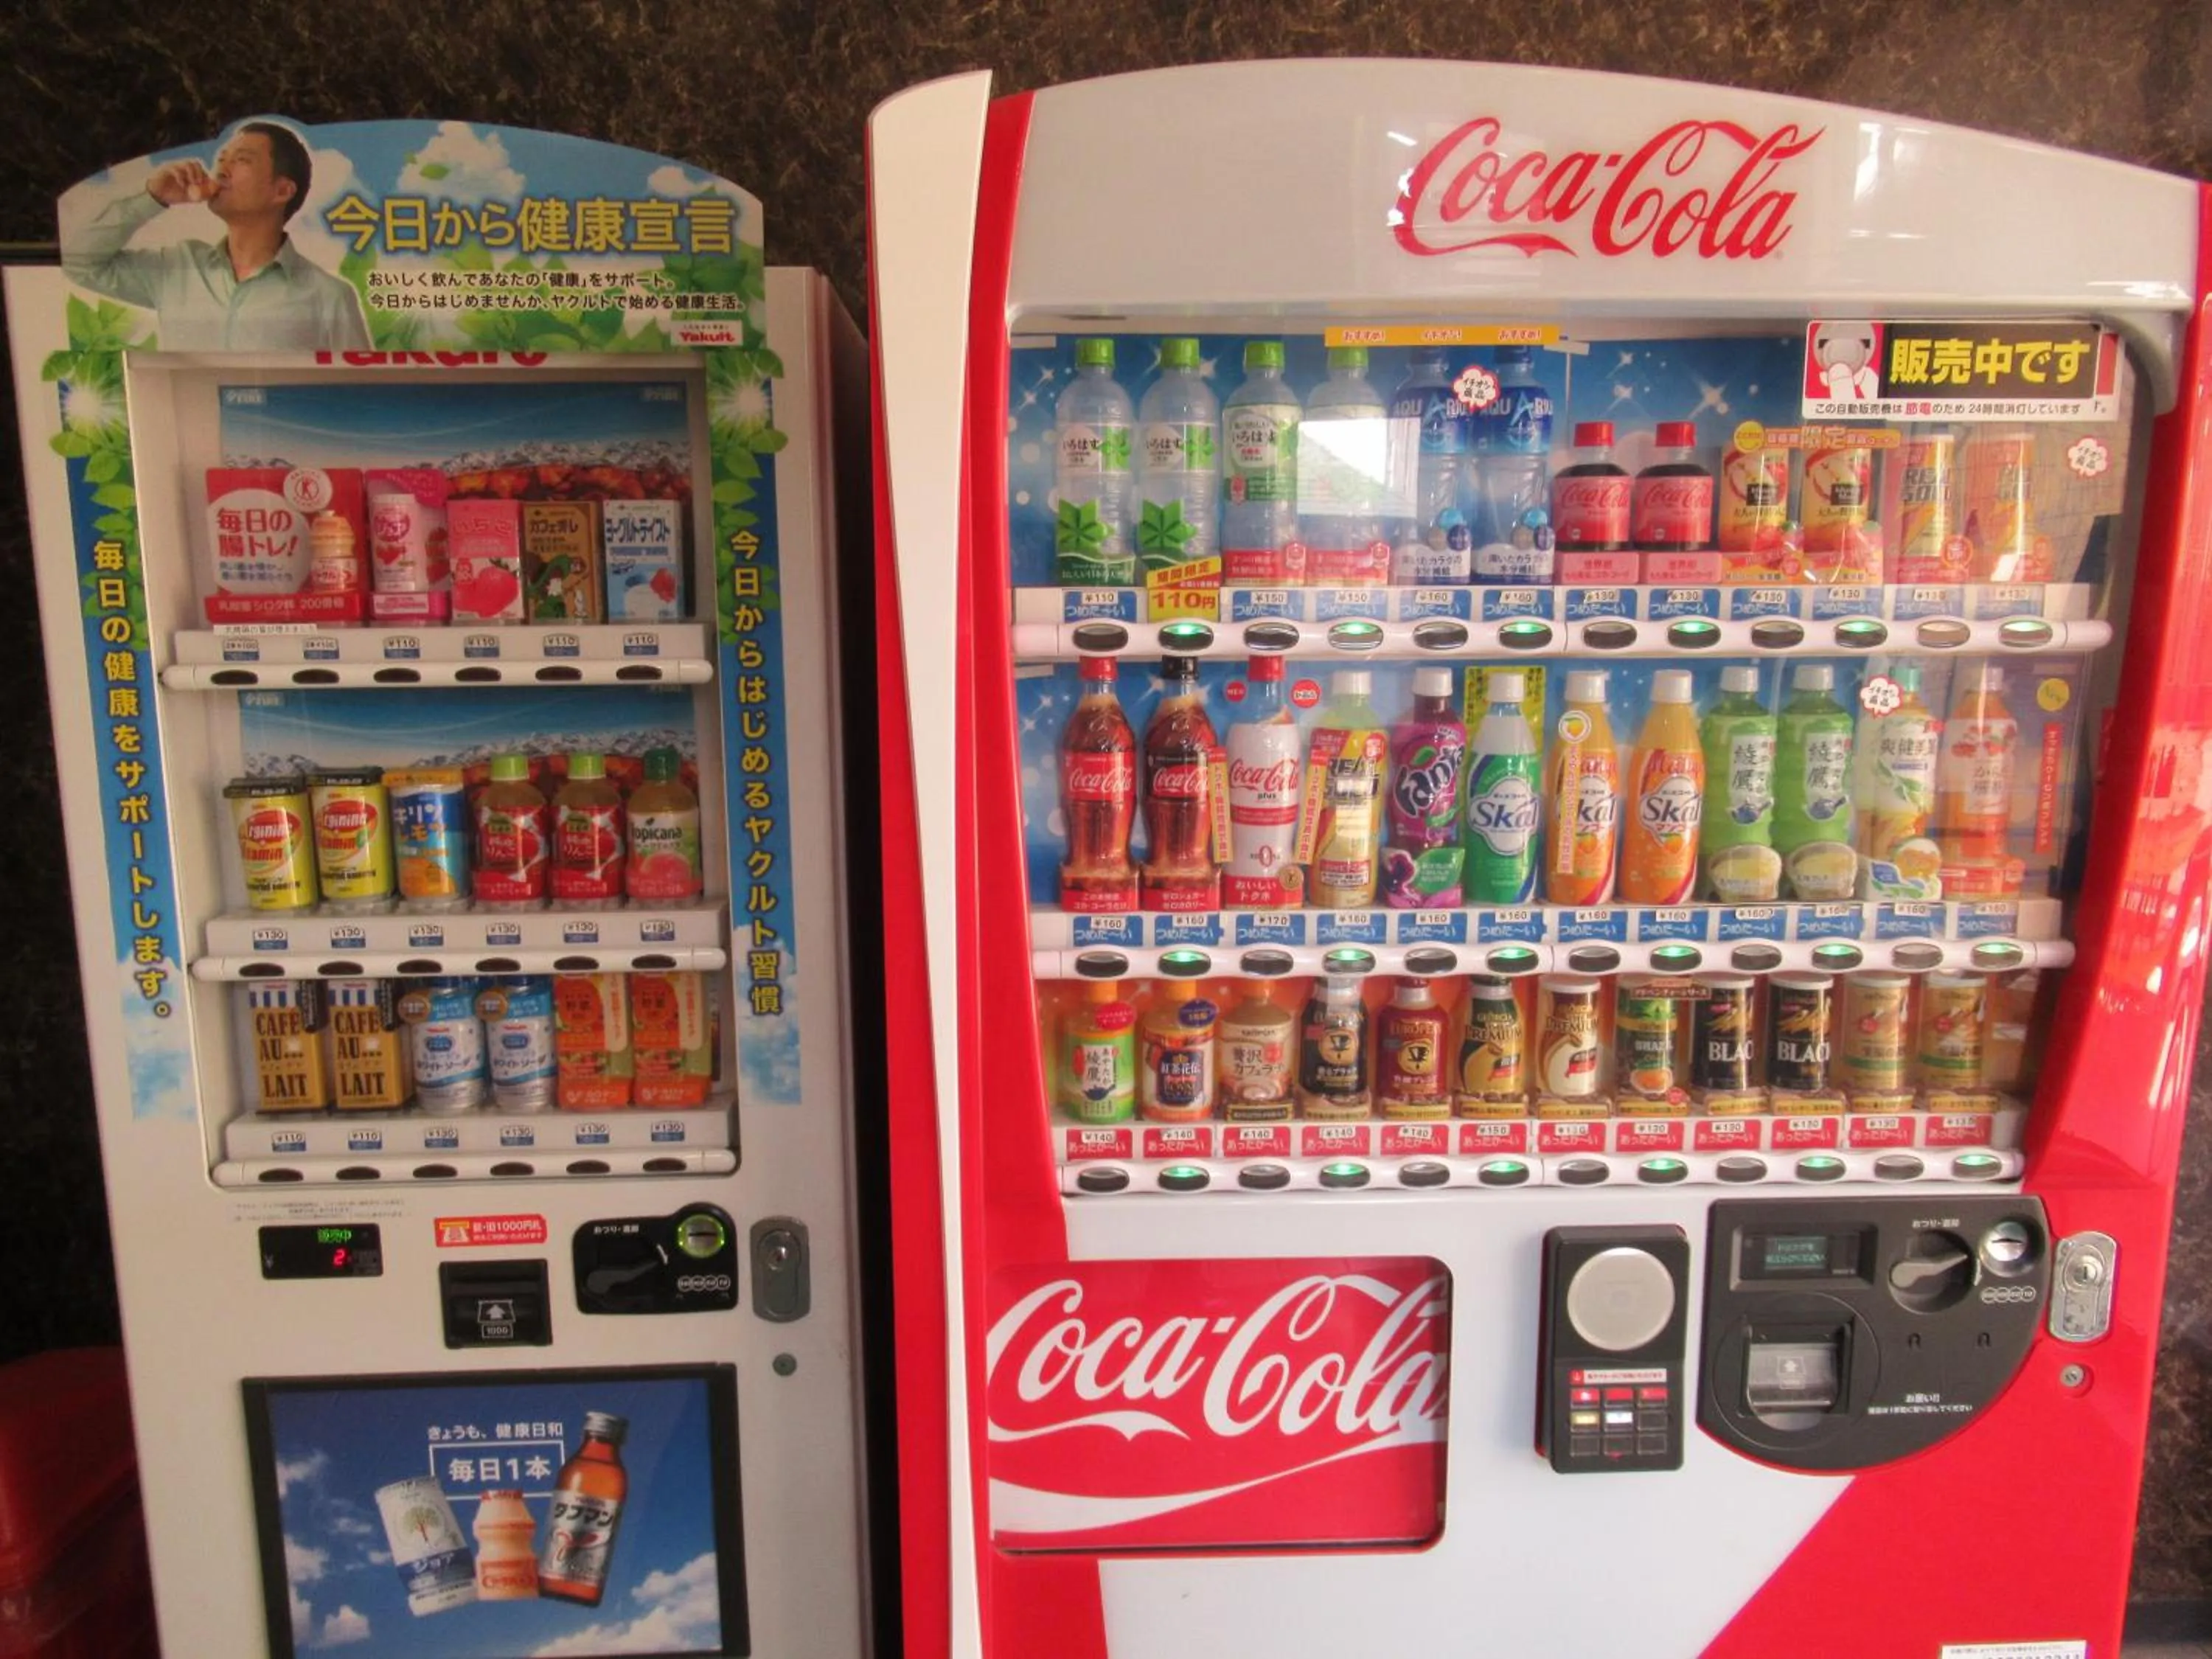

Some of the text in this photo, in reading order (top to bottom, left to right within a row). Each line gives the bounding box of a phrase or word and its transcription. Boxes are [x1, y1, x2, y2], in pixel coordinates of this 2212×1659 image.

[1393, 116, 1827, 260] Coca-Cola
[325, 195, 737, 254] 今日から健康宣言
[369, 271, 675, 290] おいしく飲んであなたの「健康」をサポート。
[370, 293, 745, 311] 今日からはじめませんか、ヤクルトで始める健康生活。
[1889, 338, 2091, 385] 販売中です
[217, 509, 293, 533] 毎日の
[1151, 593, 1216, 611] 110円
[94, 541, 171, 1018] 毎日の健康をサポートします。
[731, 530, 783, 1015] 今日からはじめるヤクルト習慣
[1069, 767, 1133, 793] Coca-Cola
[1152, 768, 1208, 793] Coca-Col
[1576, 796, 1615, 827] kal
[256, 1012, 301, 1036] CAFE
[335, 1011, 380, 1035] CAFE
[260, 1038, 282, 1062] AU
[337, 1037, 360, 1060] AU
[262, 1074, 307, 1099] LAIT
[340, 1072, 385, 1096] LAIT
[333, 1249, 348, 1266] 2
[987, 1275, 1447, 1443] Coca-Cola
[448, 1457, 552, 1483] 毎日1本
[554, 1502, 616, 1528] タフマン
[412, 1551, 455, 1573] ジョア
